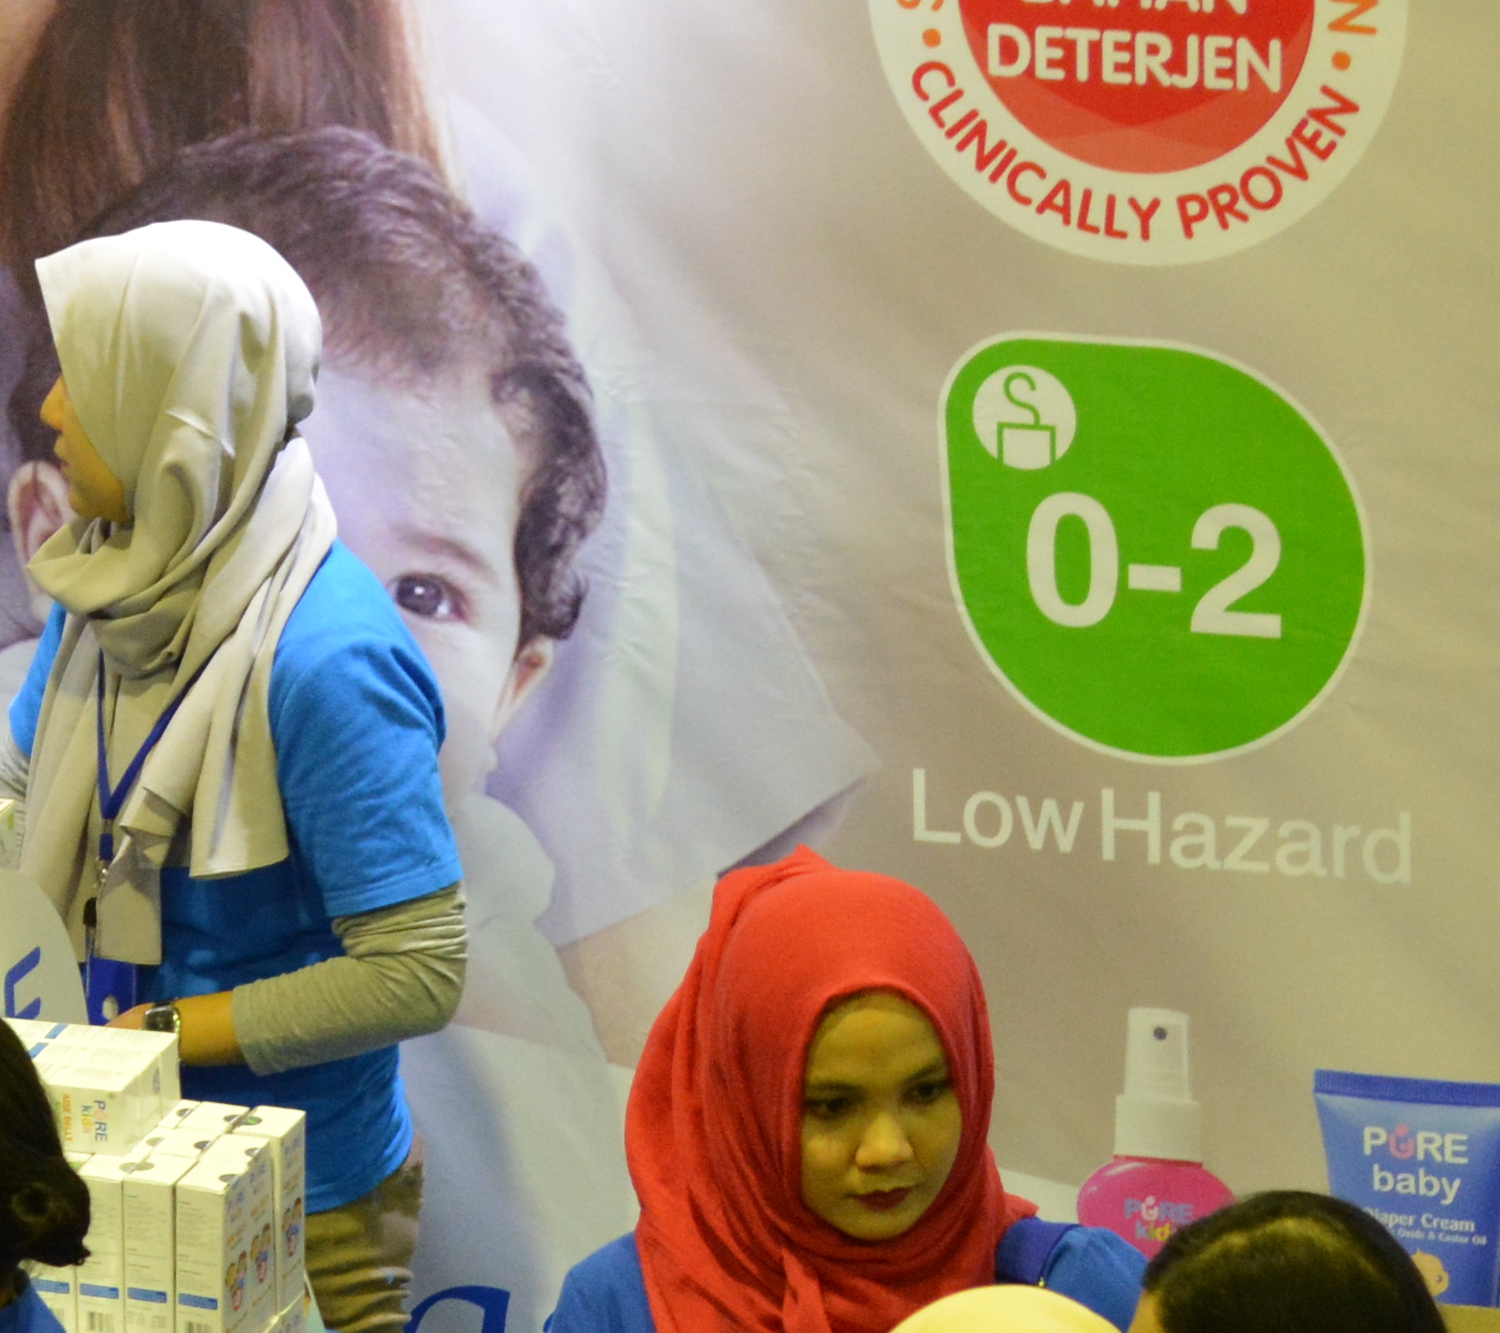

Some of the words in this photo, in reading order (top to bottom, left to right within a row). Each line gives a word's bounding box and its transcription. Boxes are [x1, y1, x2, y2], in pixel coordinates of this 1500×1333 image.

[986, 23, 1282, 92] DETERJEN
[911, 60, 1161, 241] CLINICALLY
[1176, 84, 1360, 240] PROVEN
[1025, 491, 1282, 639] 0-2
[912, 767, 1084, 854] Low
[1101, 787, 1412, 885] Hazard
[1362, 1124, 1469, 1165] PURE
[1372, 1164, 1461, 1206] baby
[1421, 1212, 1476, 1233] Cream
